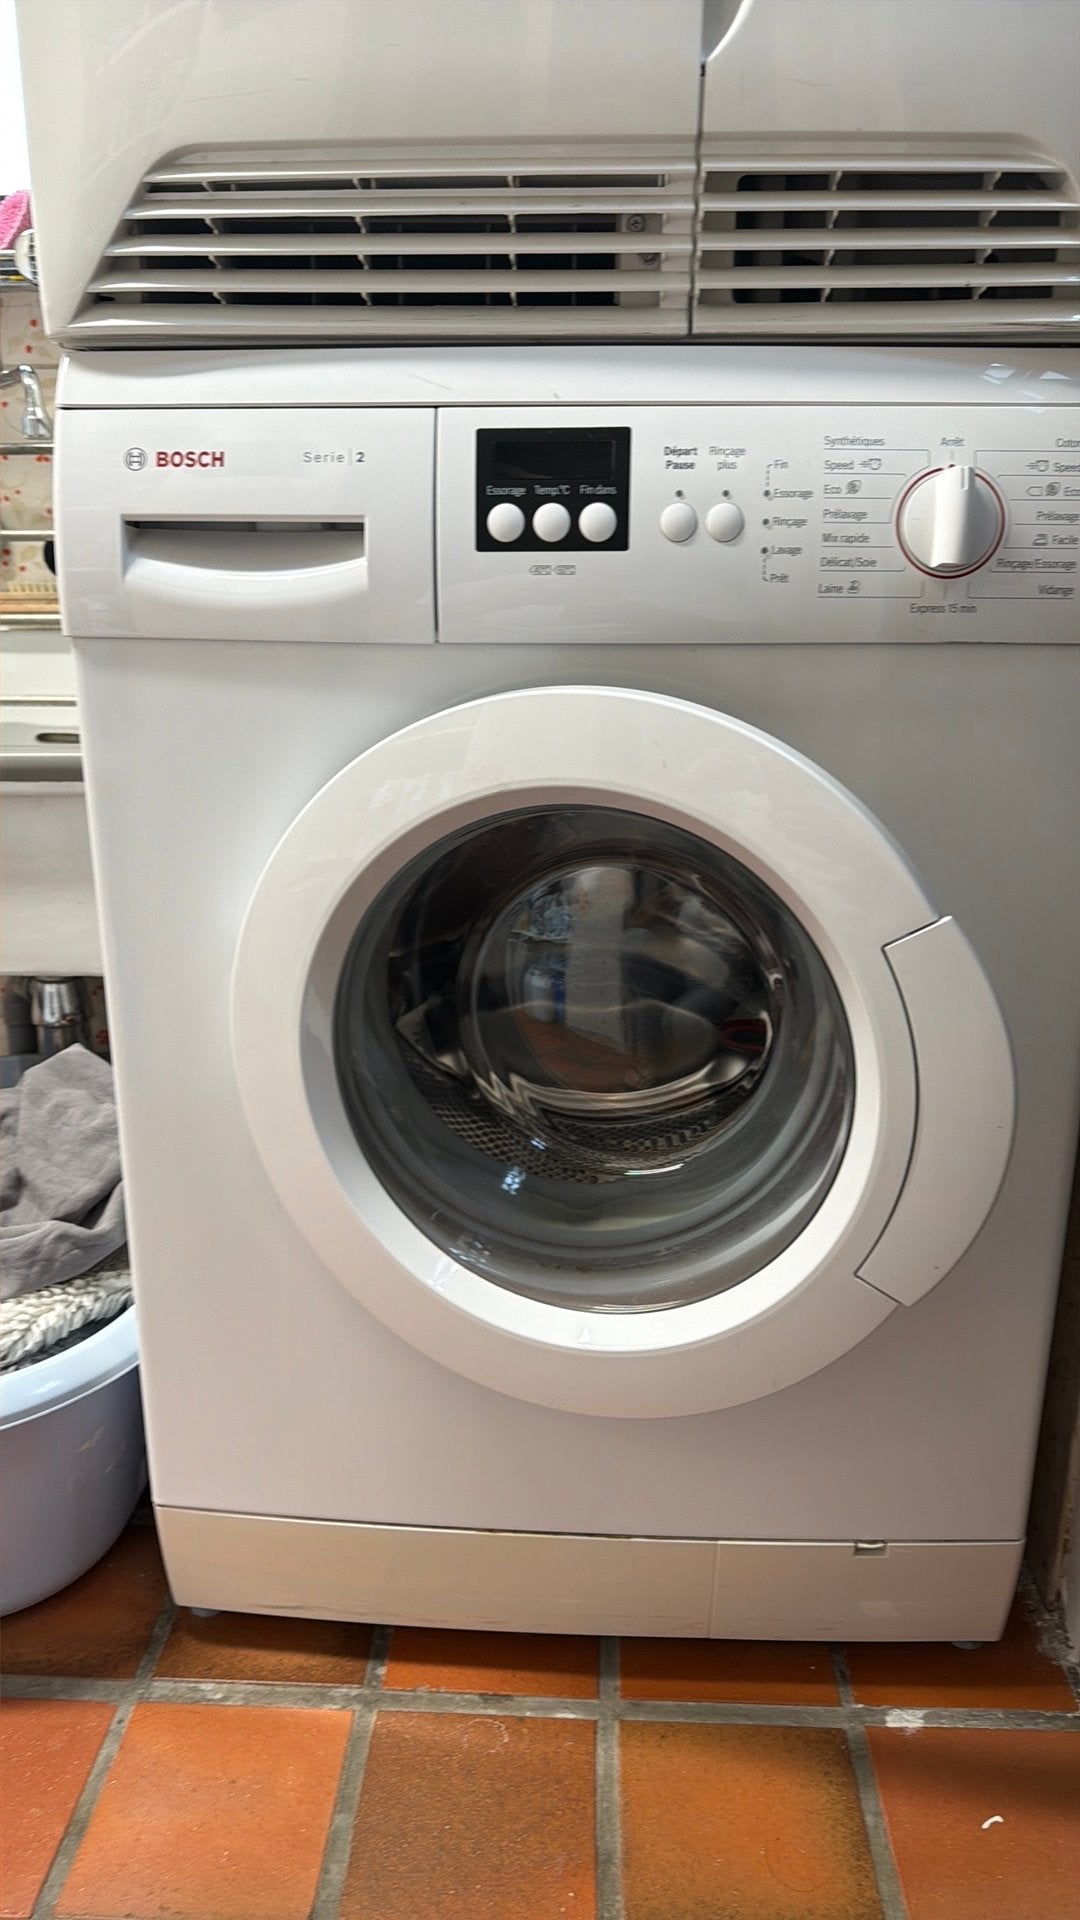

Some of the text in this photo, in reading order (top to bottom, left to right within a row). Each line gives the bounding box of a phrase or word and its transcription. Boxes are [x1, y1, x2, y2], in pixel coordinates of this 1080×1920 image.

[303, 451, 366, 463] Serie 2
[663, 446, 698, 457] Départ
[708, 445, 746, 458] Rinçage
[156, 451, 226, 468] BOSCH
[665, 460, 696, 470] Pause
[773, 459, 789, 469] Fin
[717, 460, 738, 471] plus
[823, 460, 854, 471] Speed
[485, 485, 527, 497] Essorage
[773, 489, 814, 500] Essorage
[824, 484, 842, 495] Eco
[771, 517, 808, 528] Rinçage
[1052, 535, 1079, 545] Facile
[771, 546, 803, 556] Lavage
[818, 583, 844, 594] Laine
[1039, 584, 1075, 596] Vidange
[910, 602, 946, 614] Express
[961, 603, 977, 613] min
